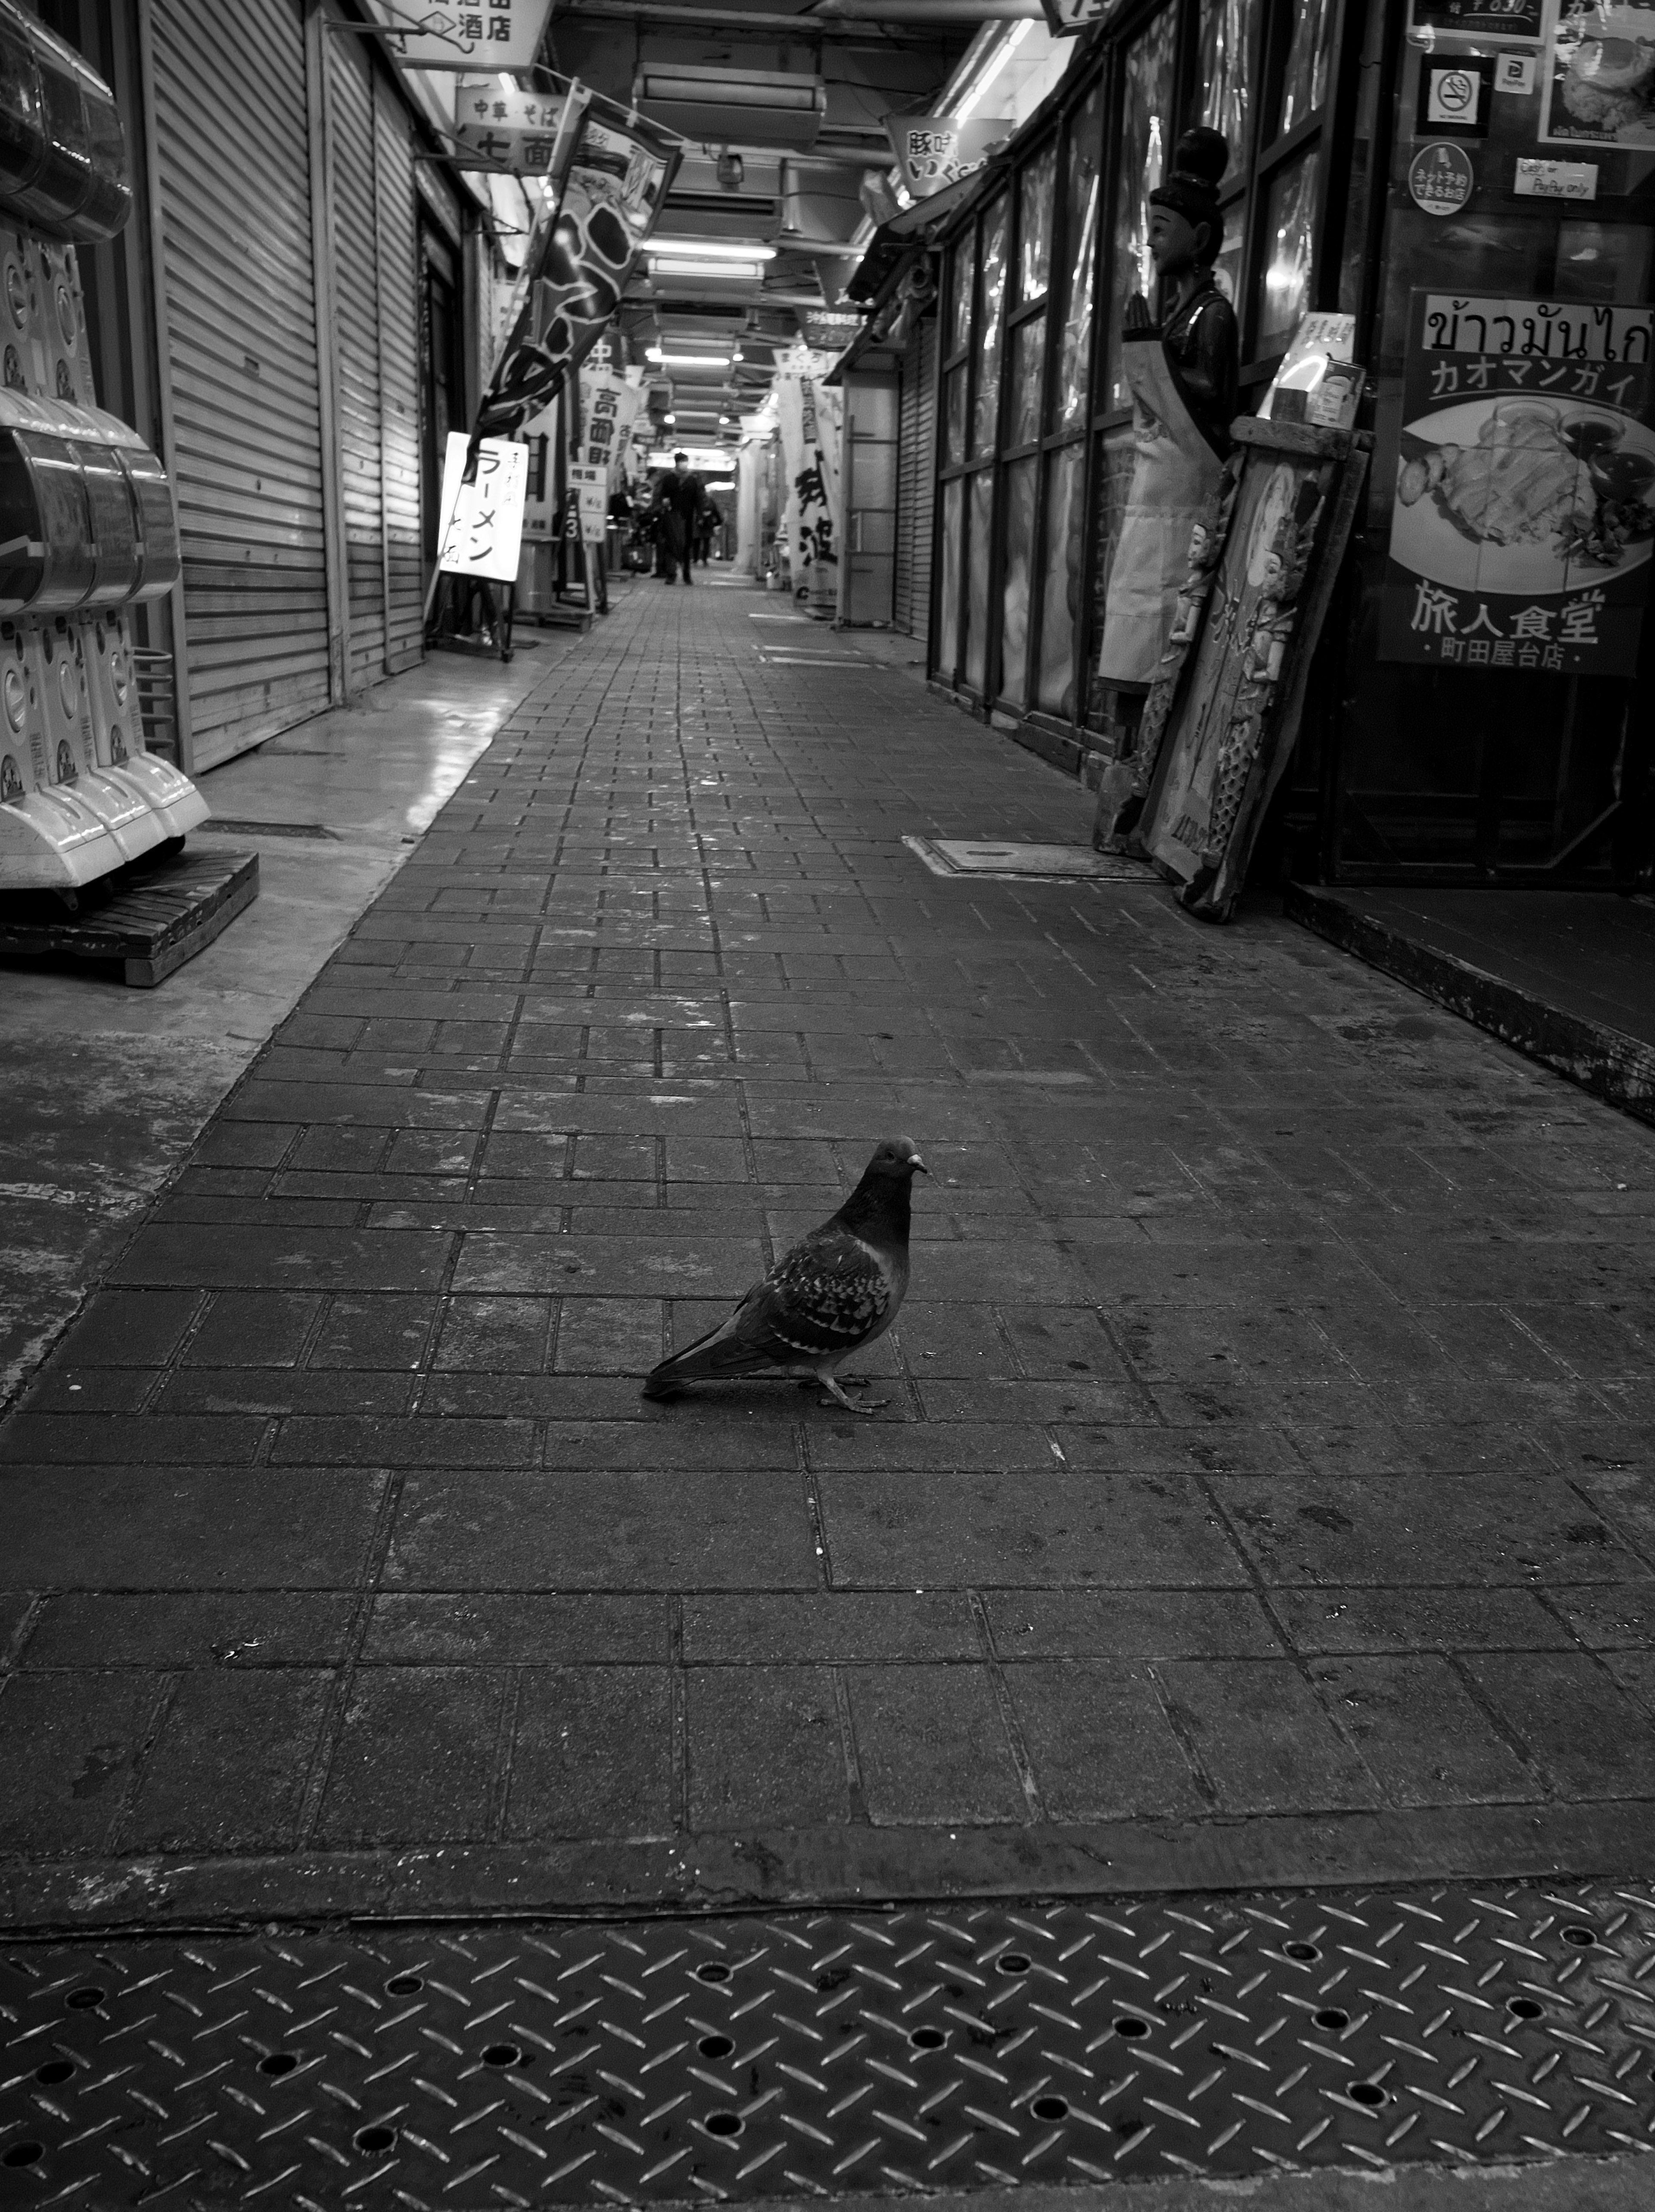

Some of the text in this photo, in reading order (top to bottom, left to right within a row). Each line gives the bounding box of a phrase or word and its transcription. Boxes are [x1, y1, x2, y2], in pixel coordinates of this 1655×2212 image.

[459, 13, 510, 41] 酒店
[477, 131, 556, 166] 七面
[1415, 184, 1466, 200] できるお店
[1432, 356, 1635, 403] カオマンガイ
[469, 449, 500, 561] ラーメン
[1410, 578, 1605, 644] 旅人食堂
[1441, 637, 1564, 669] 町田屋台店
